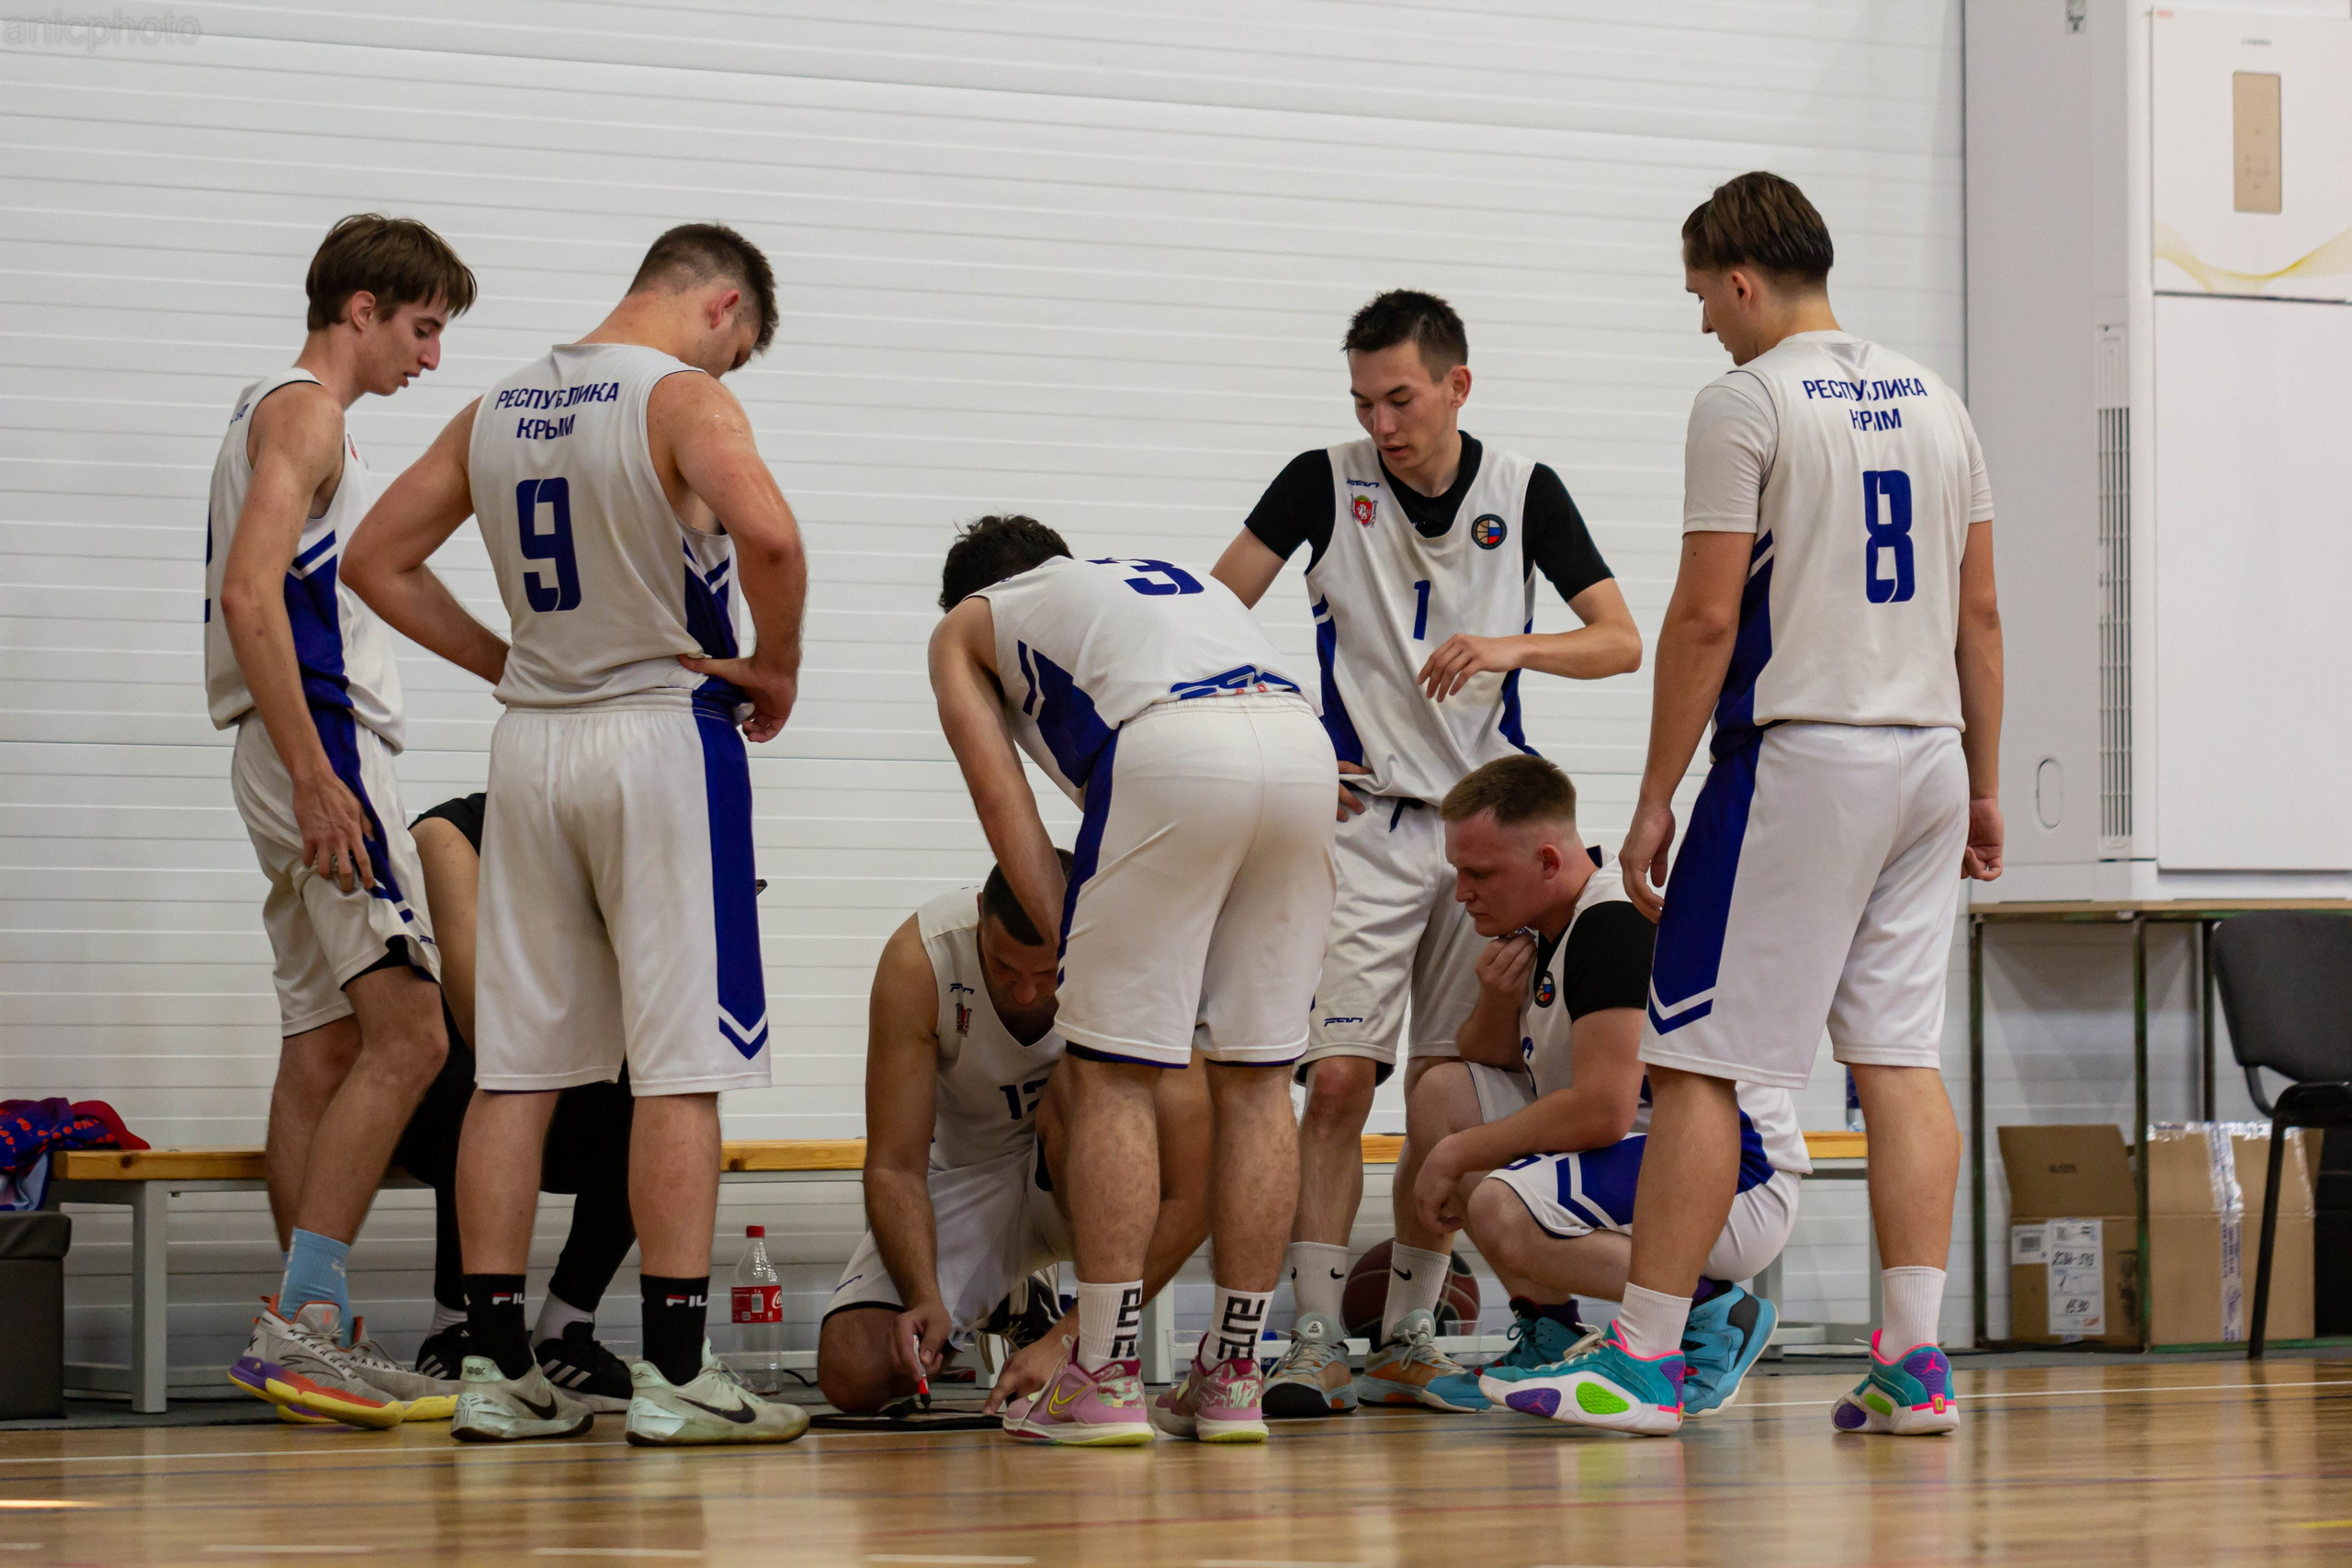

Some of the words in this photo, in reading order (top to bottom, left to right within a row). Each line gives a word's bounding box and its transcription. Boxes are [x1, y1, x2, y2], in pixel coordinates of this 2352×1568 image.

[494, 382, 619, 410] РЕСПУБЛИКА
[1802, 378, 1928, 401] РЕСПУЛИКА
[516, 414, 576, 440] КРЫМ
[515, 477, 582, 613] 9
[1862, 469, 1915, 604] 8
[1413, 580, 1430, 640] 1
